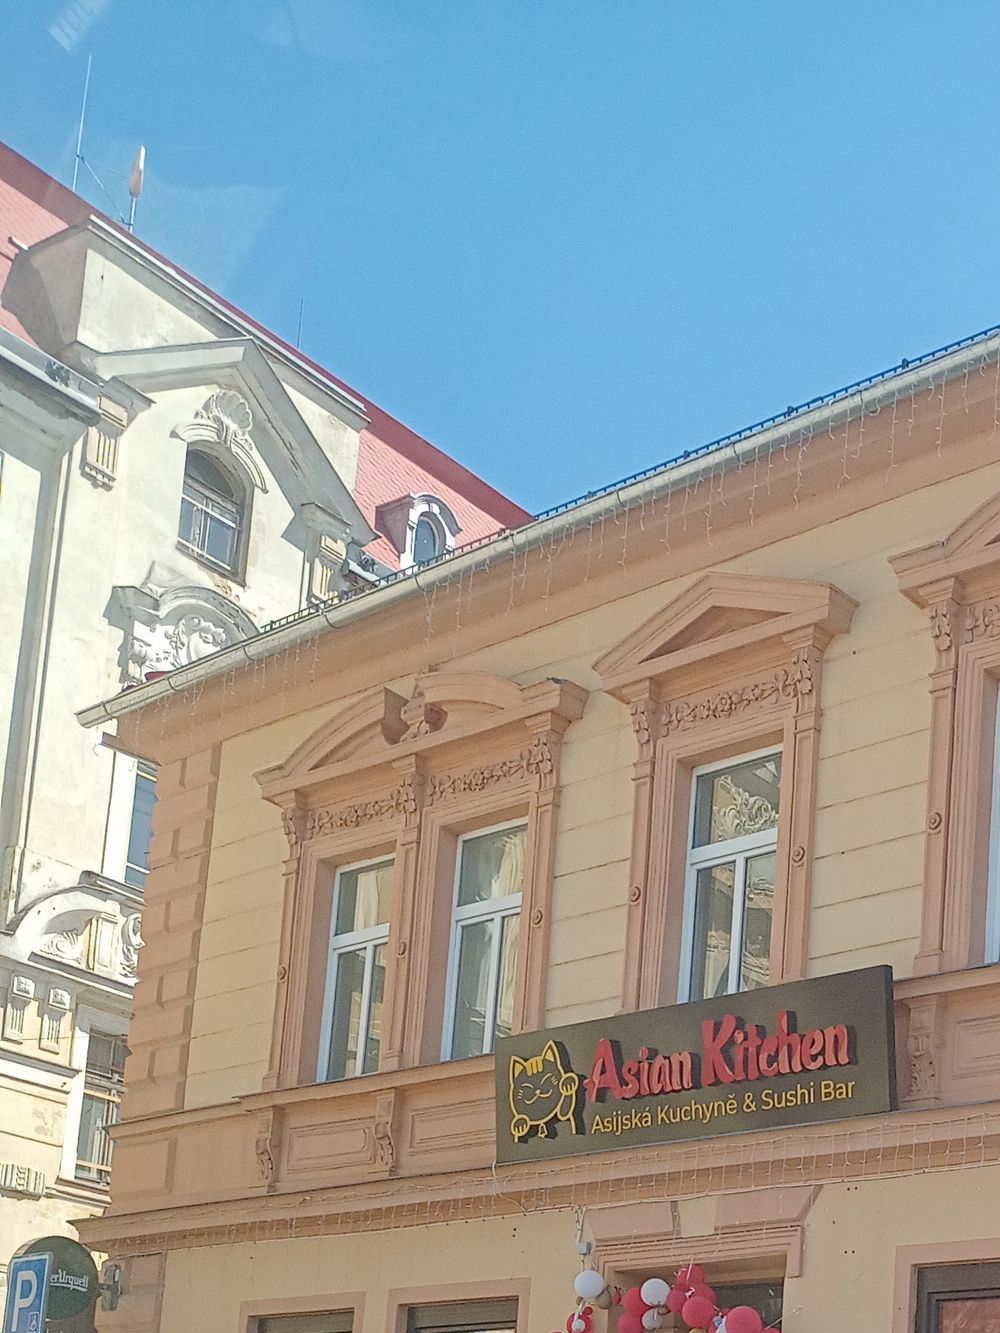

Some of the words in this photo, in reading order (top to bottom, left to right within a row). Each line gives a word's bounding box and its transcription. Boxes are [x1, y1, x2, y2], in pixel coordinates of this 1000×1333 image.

[584, 1038, 693, 1102] Asian
[702, 1009, 849, 1086] Kitchen
[591, 1109, 652, 1135] Asijská
[657, 1094, 737, 1125] Kuchyně
[743, 1092, 757, 1112] &
[761, 1081, 815, 1111] Sushi
[820, 1078, 856, 1102] Bar
[11, 1270, 38, 1333] P
[58, 1268, 88, 1291] Urquell
